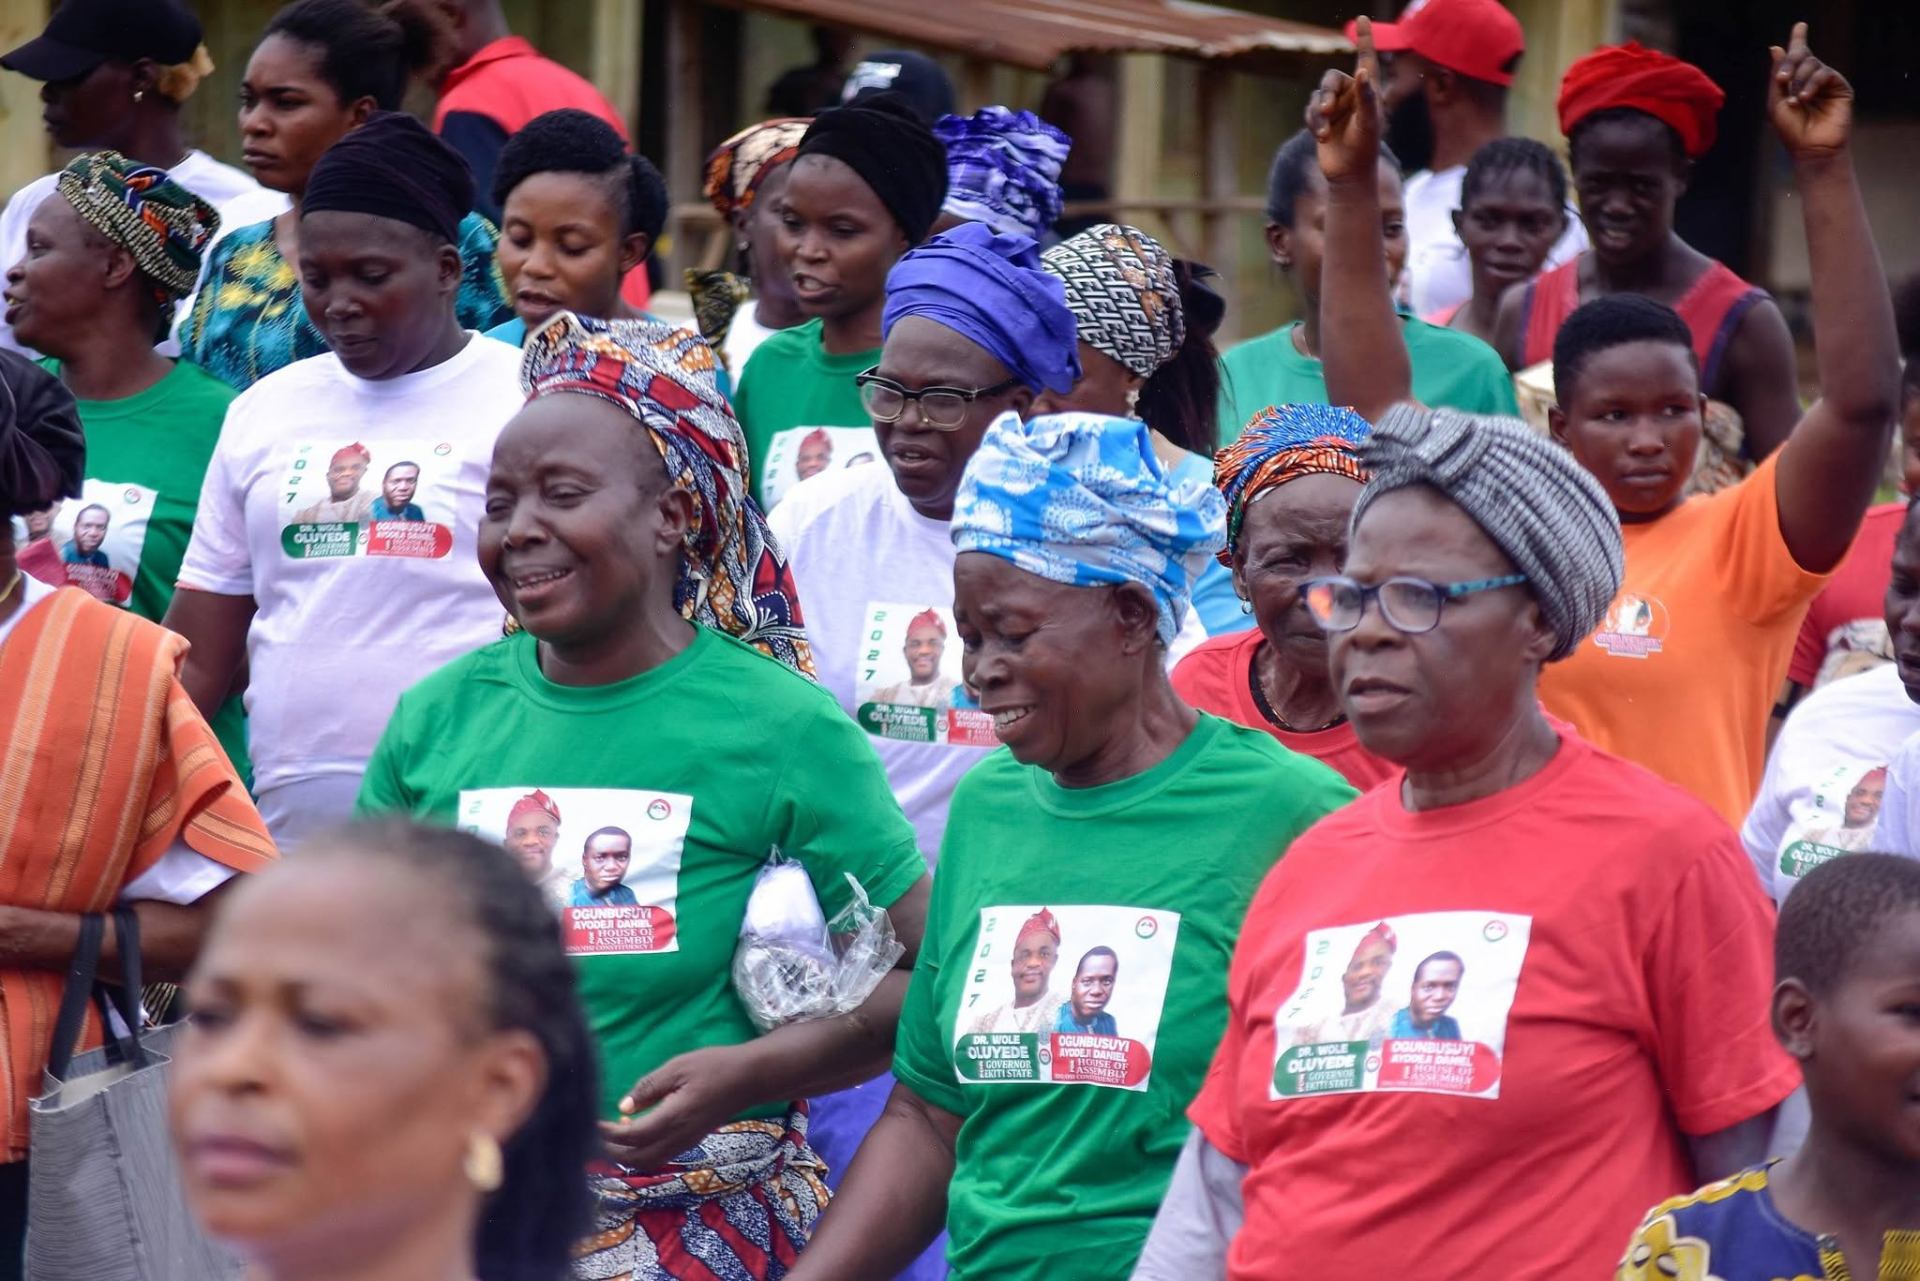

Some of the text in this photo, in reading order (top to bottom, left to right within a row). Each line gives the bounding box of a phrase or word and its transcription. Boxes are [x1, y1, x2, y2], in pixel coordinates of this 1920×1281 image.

[294, 532, 351, 544] OLUYEDE
[865, 611, 886, 681] 2027
[572, 907, 652, 920] OGUNBUSUYI
[573, 919, 652, 930] AYODEJI DANIEL
[598, 928, 637, 938] HOUSE
[596, 936, 655, 946] ASSEMBLY
[969, 917, 997, 1008] 2027
[973, 1035, 1020, 1045] DR. WOLE
[1058, 1035, 1130, 1053] OGUNBUSUYI
[968, 1046, 1029, 1059] OLUYEDE
[1060, 1047, 1127, 1062] AYODEJI DANIEL
[1298, 1043, 1349, 1058] DR. WOLE
[1391, 1041, 1476, 1056] OGUNBUSUYI
[986, 1060, 1032, 1069] GOVERNOR
[1077, 1058, 1129, 1071] HOUSE OF
[1287, 1054, 1357, 1074] OLUYEDE
[985, 1069, 1032, 1078] EKITI STATE
[1076, 1066, 1128, 1080] ASSEMBLY
[1308, 1069, 1355, 1081] GOVERNOR
